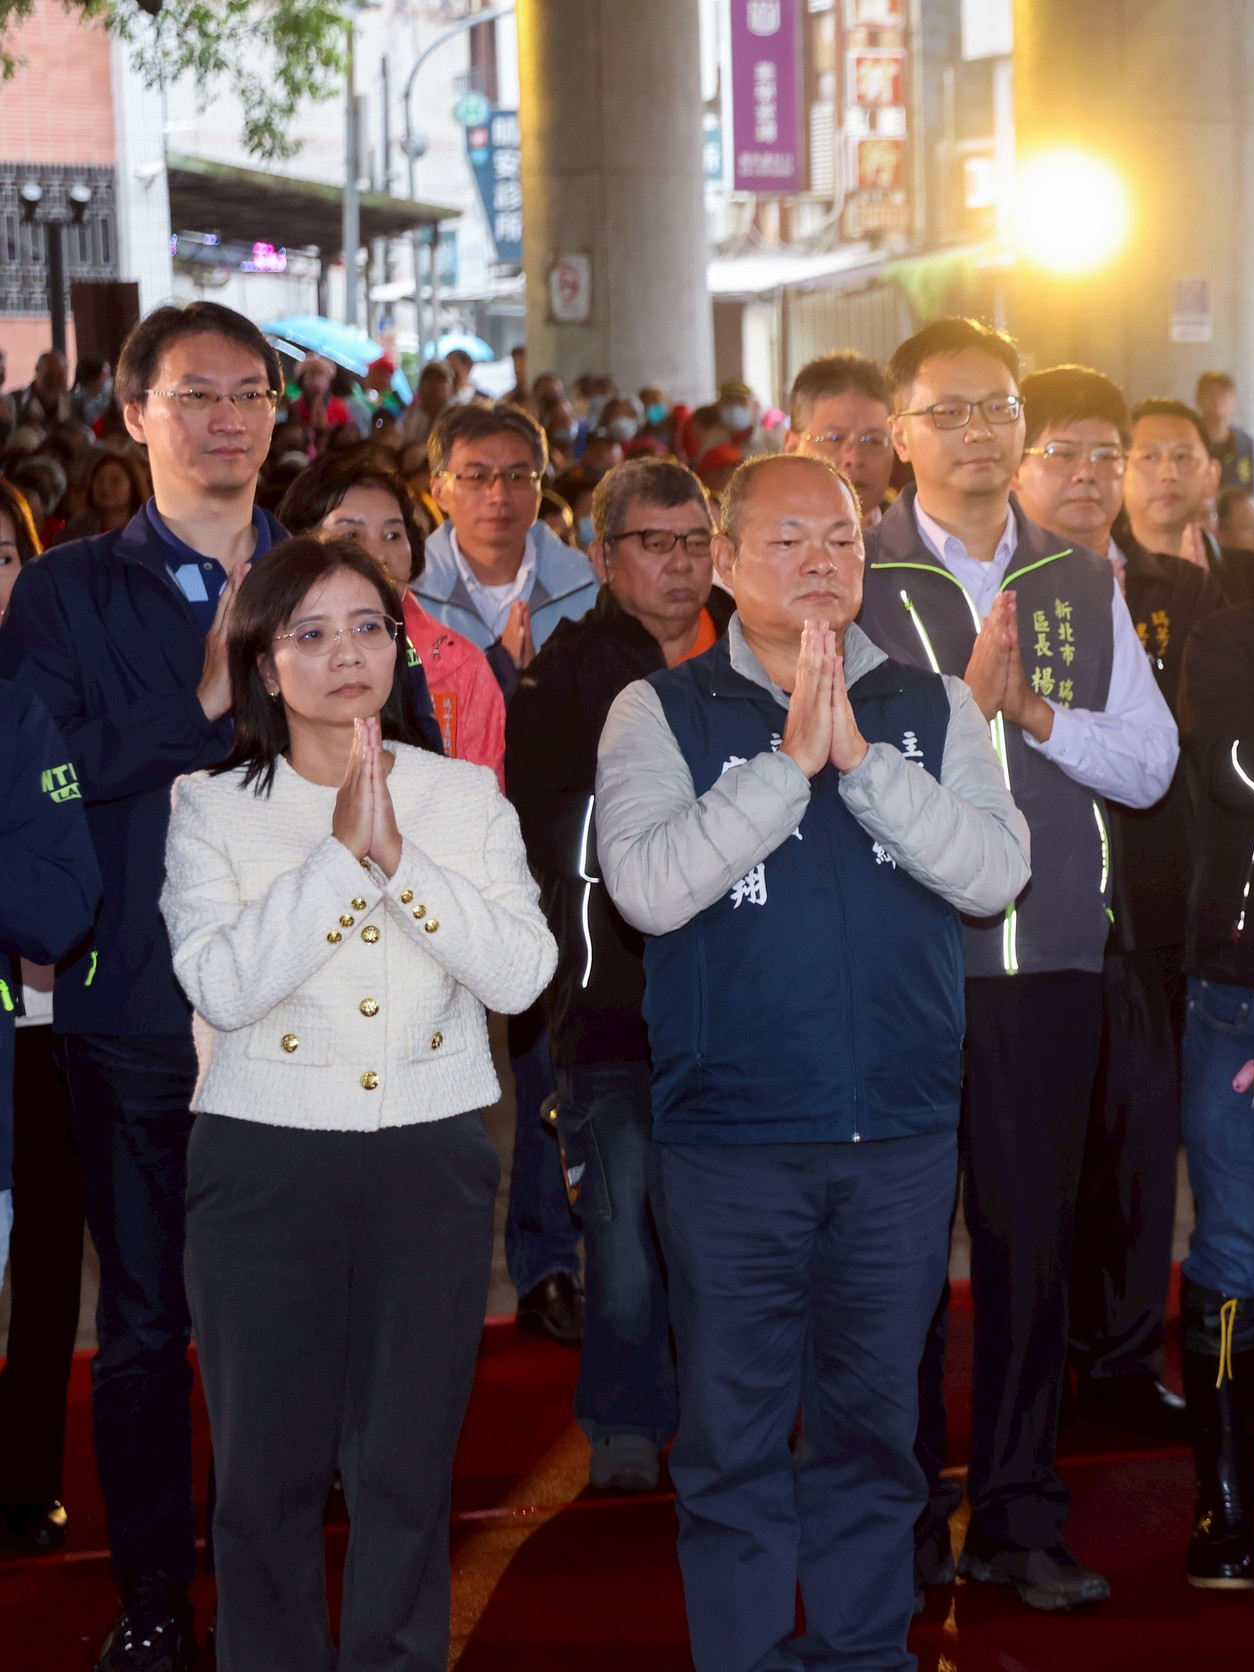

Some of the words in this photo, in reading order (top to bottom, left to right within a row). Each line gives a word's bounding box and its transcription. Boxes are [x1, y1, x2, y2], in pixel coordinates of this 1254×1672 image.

[1033, 610, 1054, 657] 區長
[1054, 598, 1076, 666] 新北市
